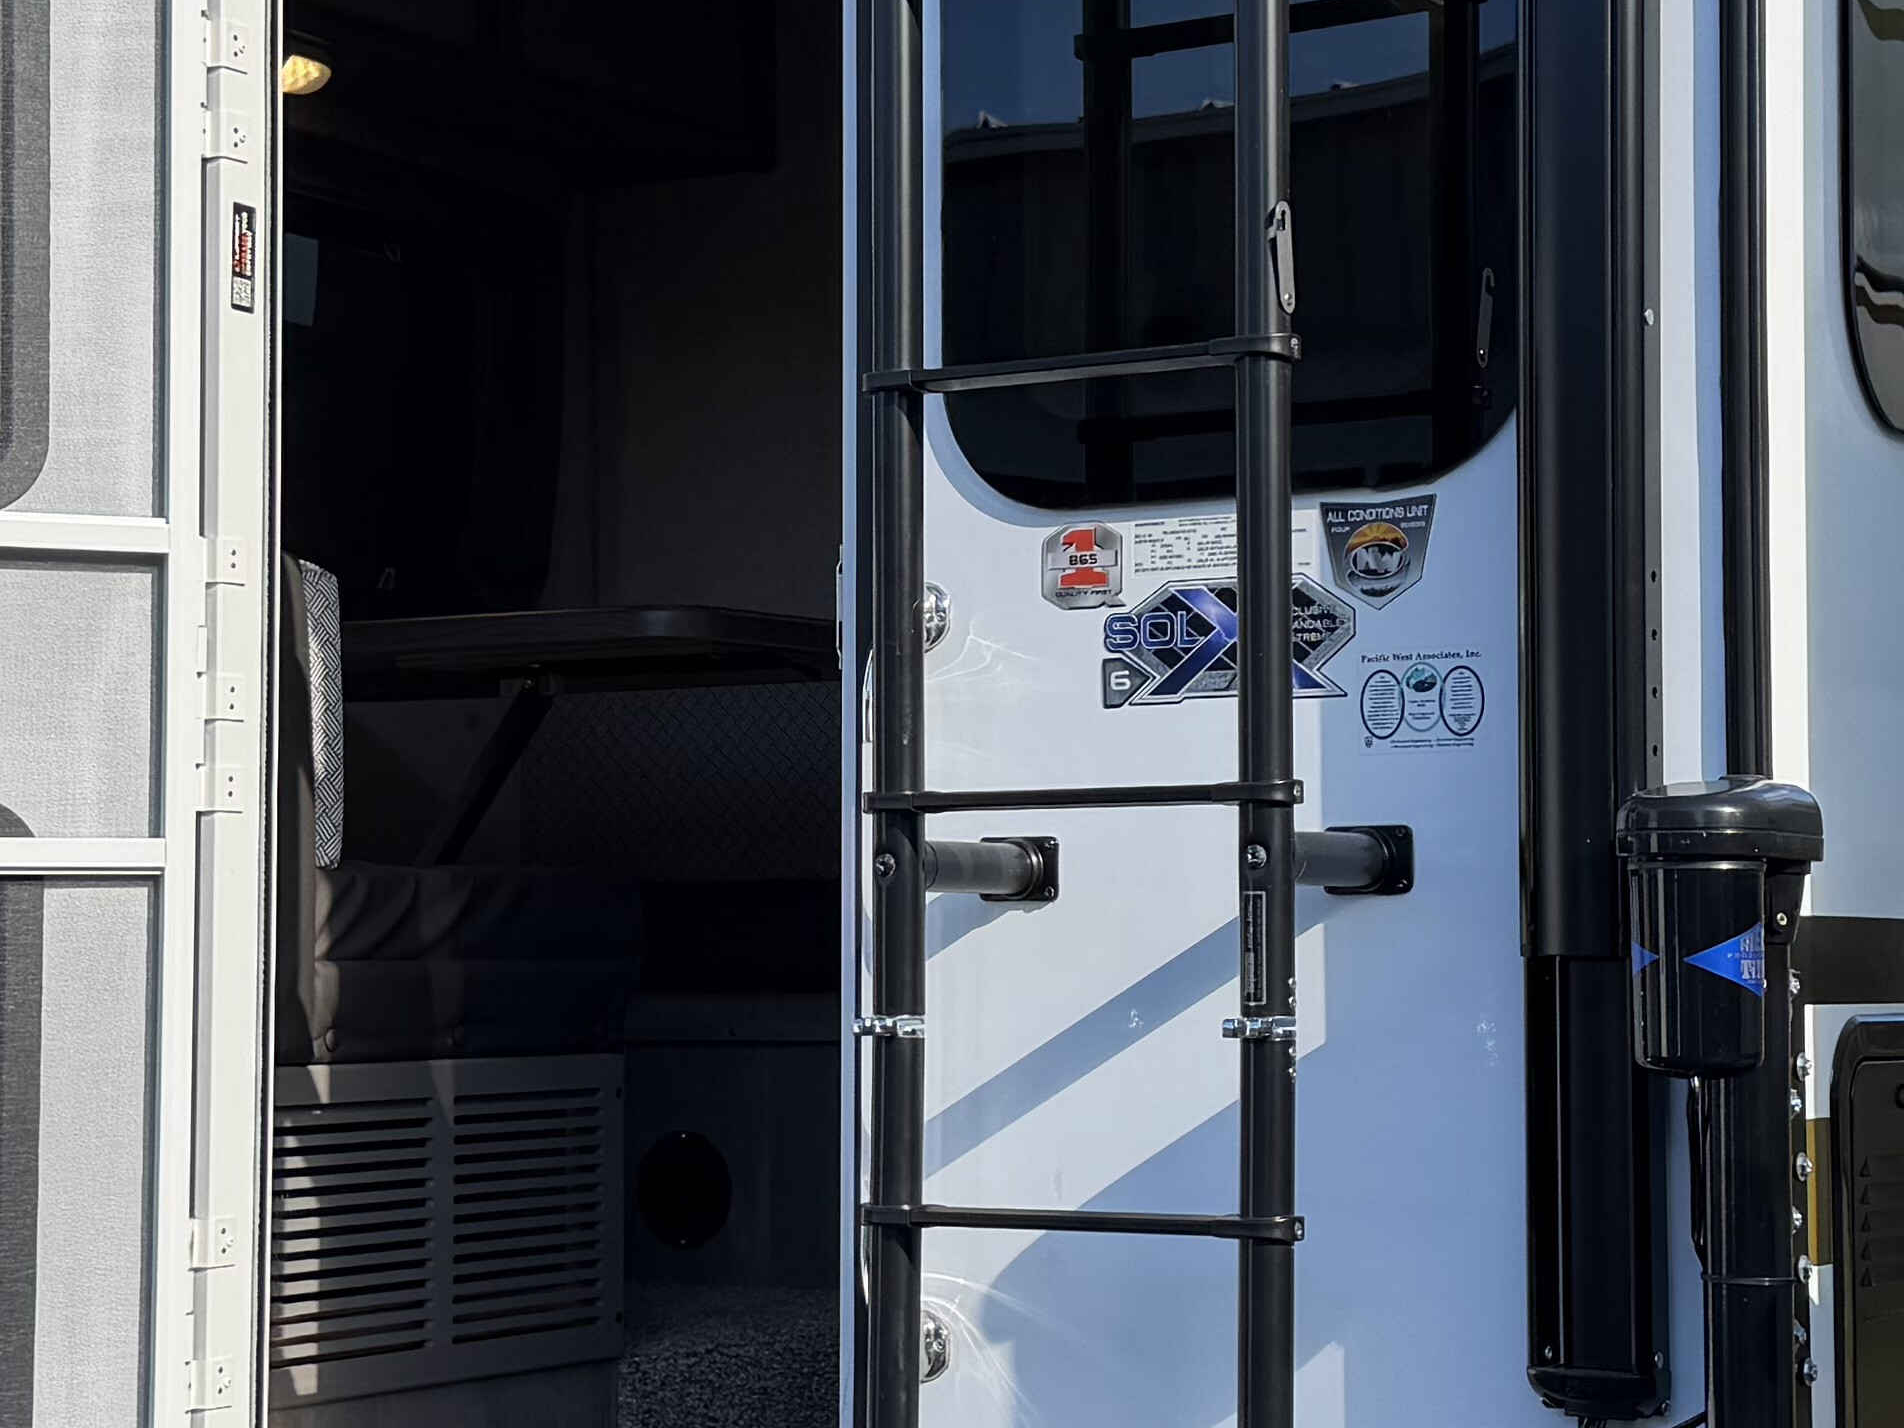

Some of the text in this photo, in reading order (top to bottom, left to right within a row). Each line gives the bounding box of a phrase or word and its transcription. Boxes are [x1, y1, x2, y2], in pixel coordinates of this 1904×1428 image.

[1327, 505, 1428, 522] ALL CONDITIONS UNIT
[1110, 670, 1131, 690] 6
